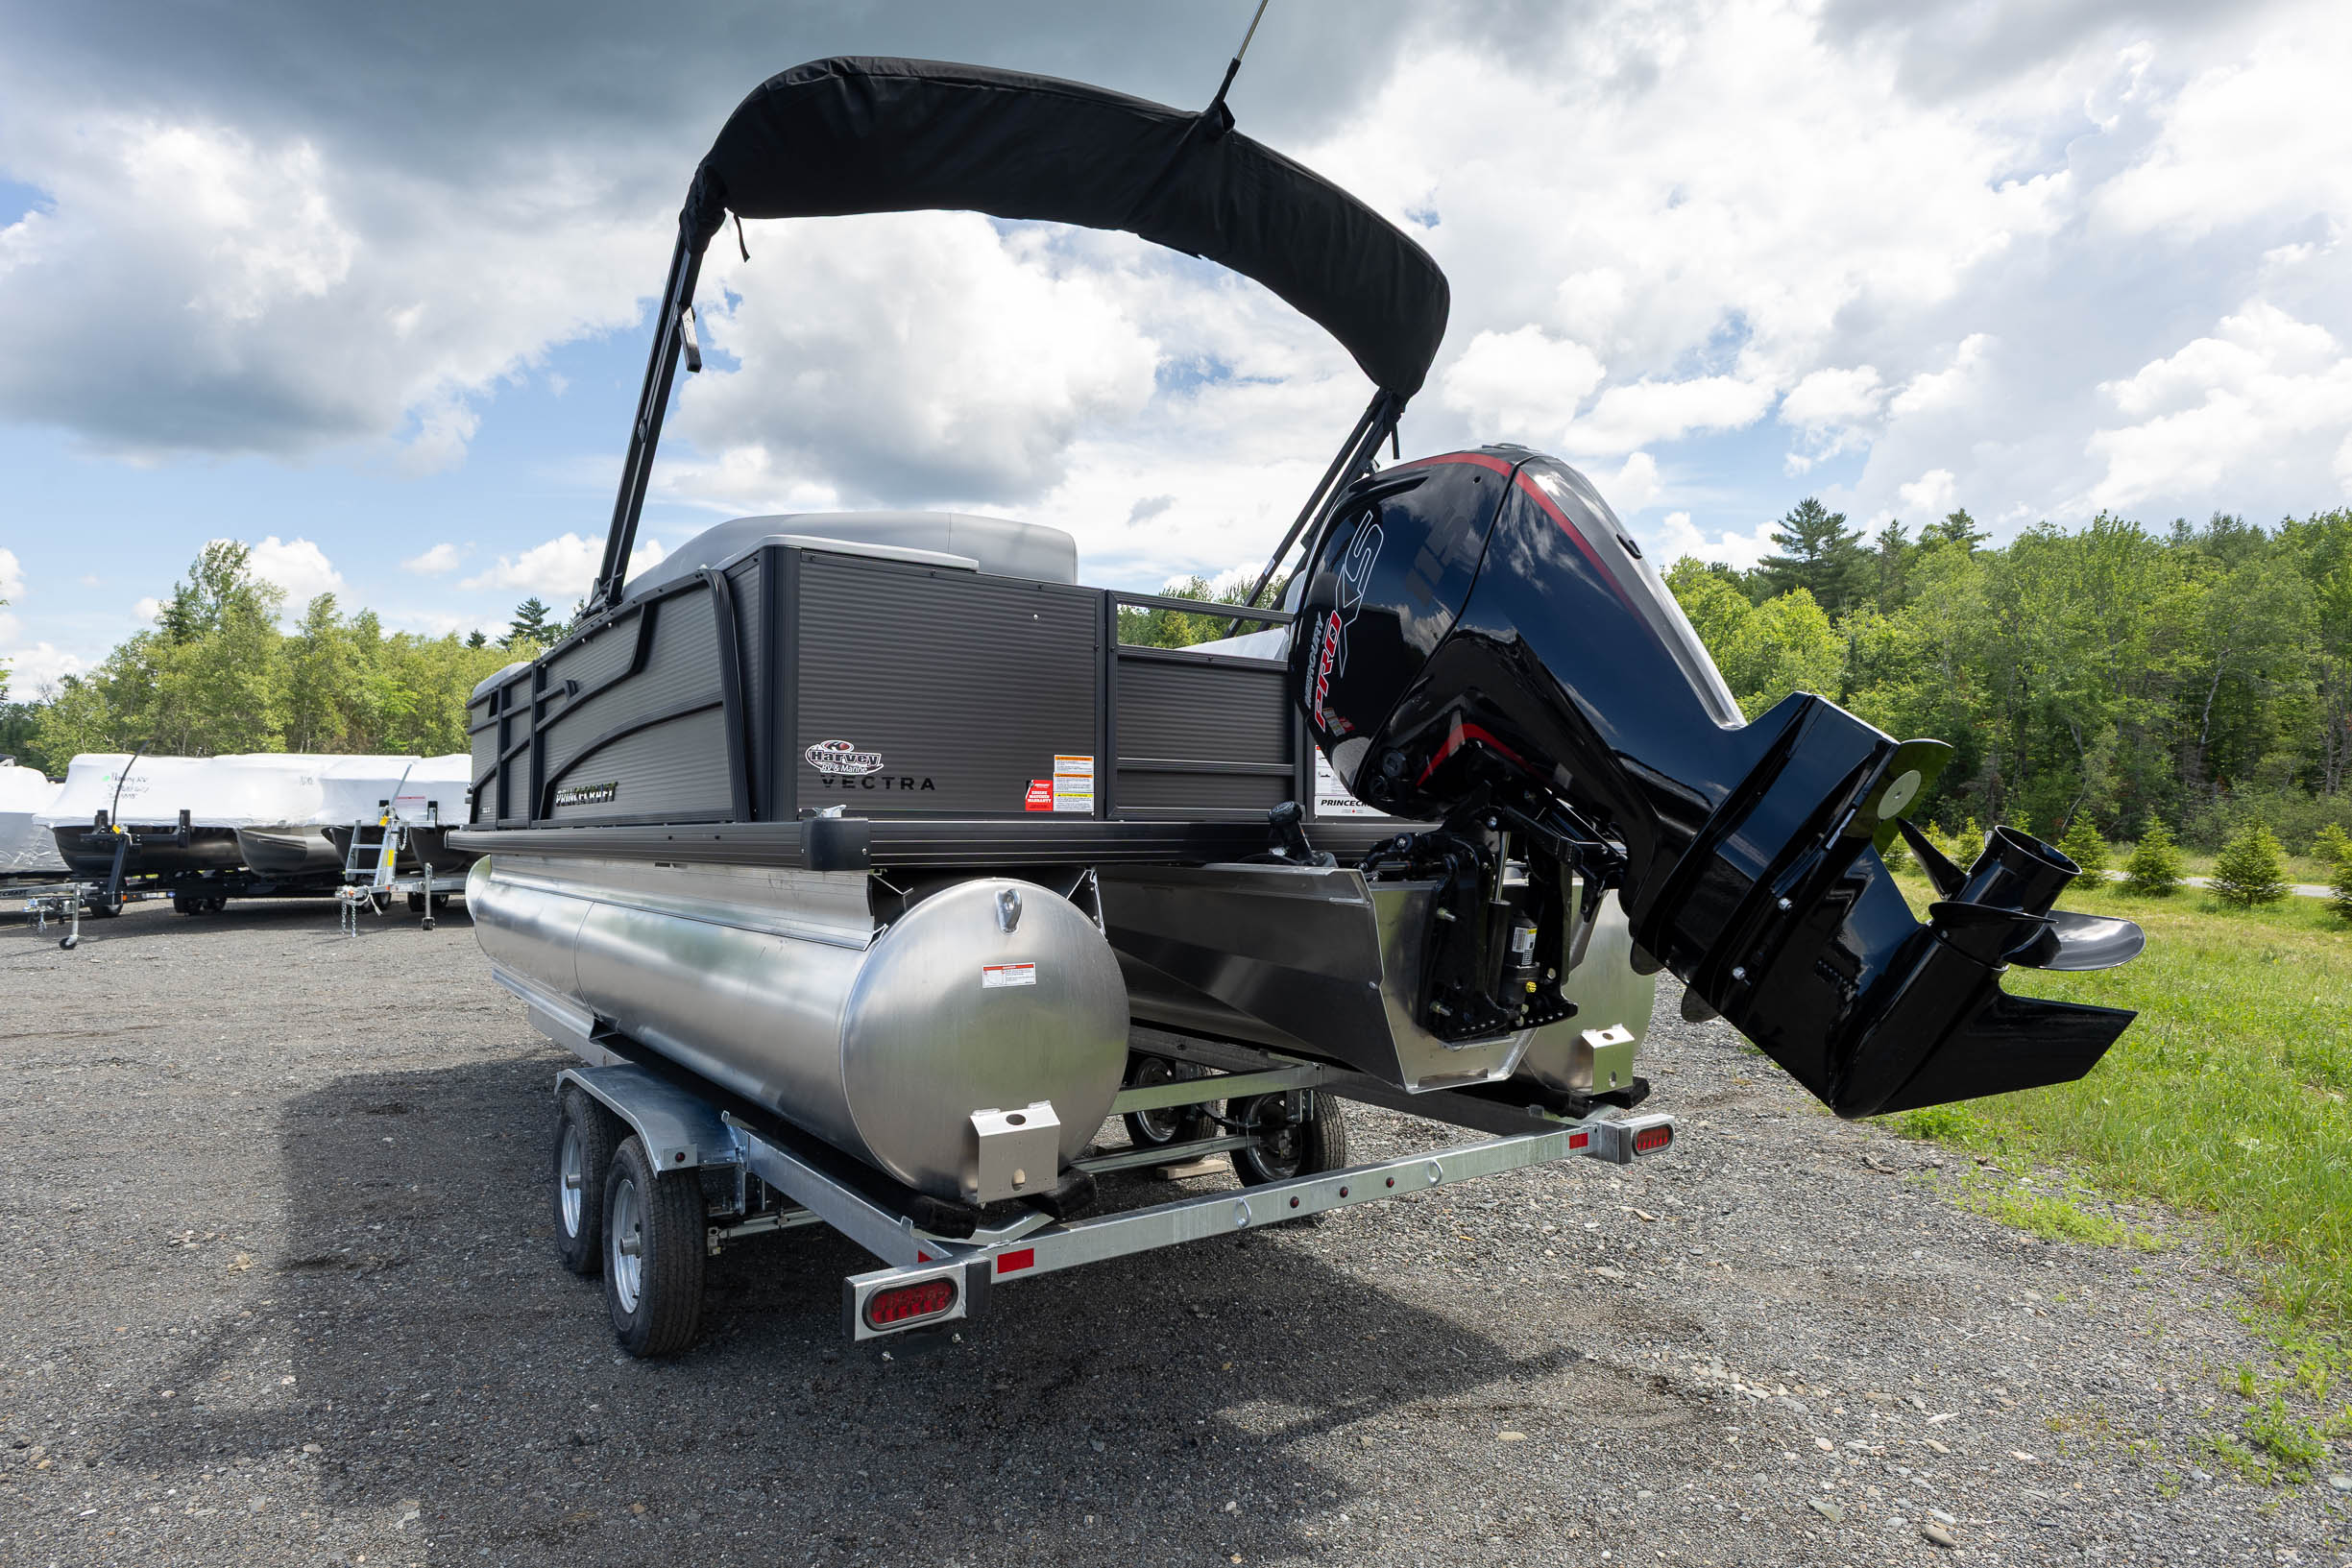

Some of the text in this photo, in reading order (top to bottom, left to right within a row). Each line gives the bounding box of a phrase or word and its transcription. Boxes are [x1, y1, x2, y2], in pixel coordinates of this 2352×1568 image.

[1315, 610, 1342, 733] PRO
[1336, 510, 1384, 679] XS
[1304, 612, 1323, 710] MERCURY
[811, 751, 880, 767] Harvey
[821, 763, 834, 772] RV
[841, 764, 868, 774] Marine
[820, 775, 935, 790] VECTRA
[1321, 799, 1369, 808] PRINCEC
